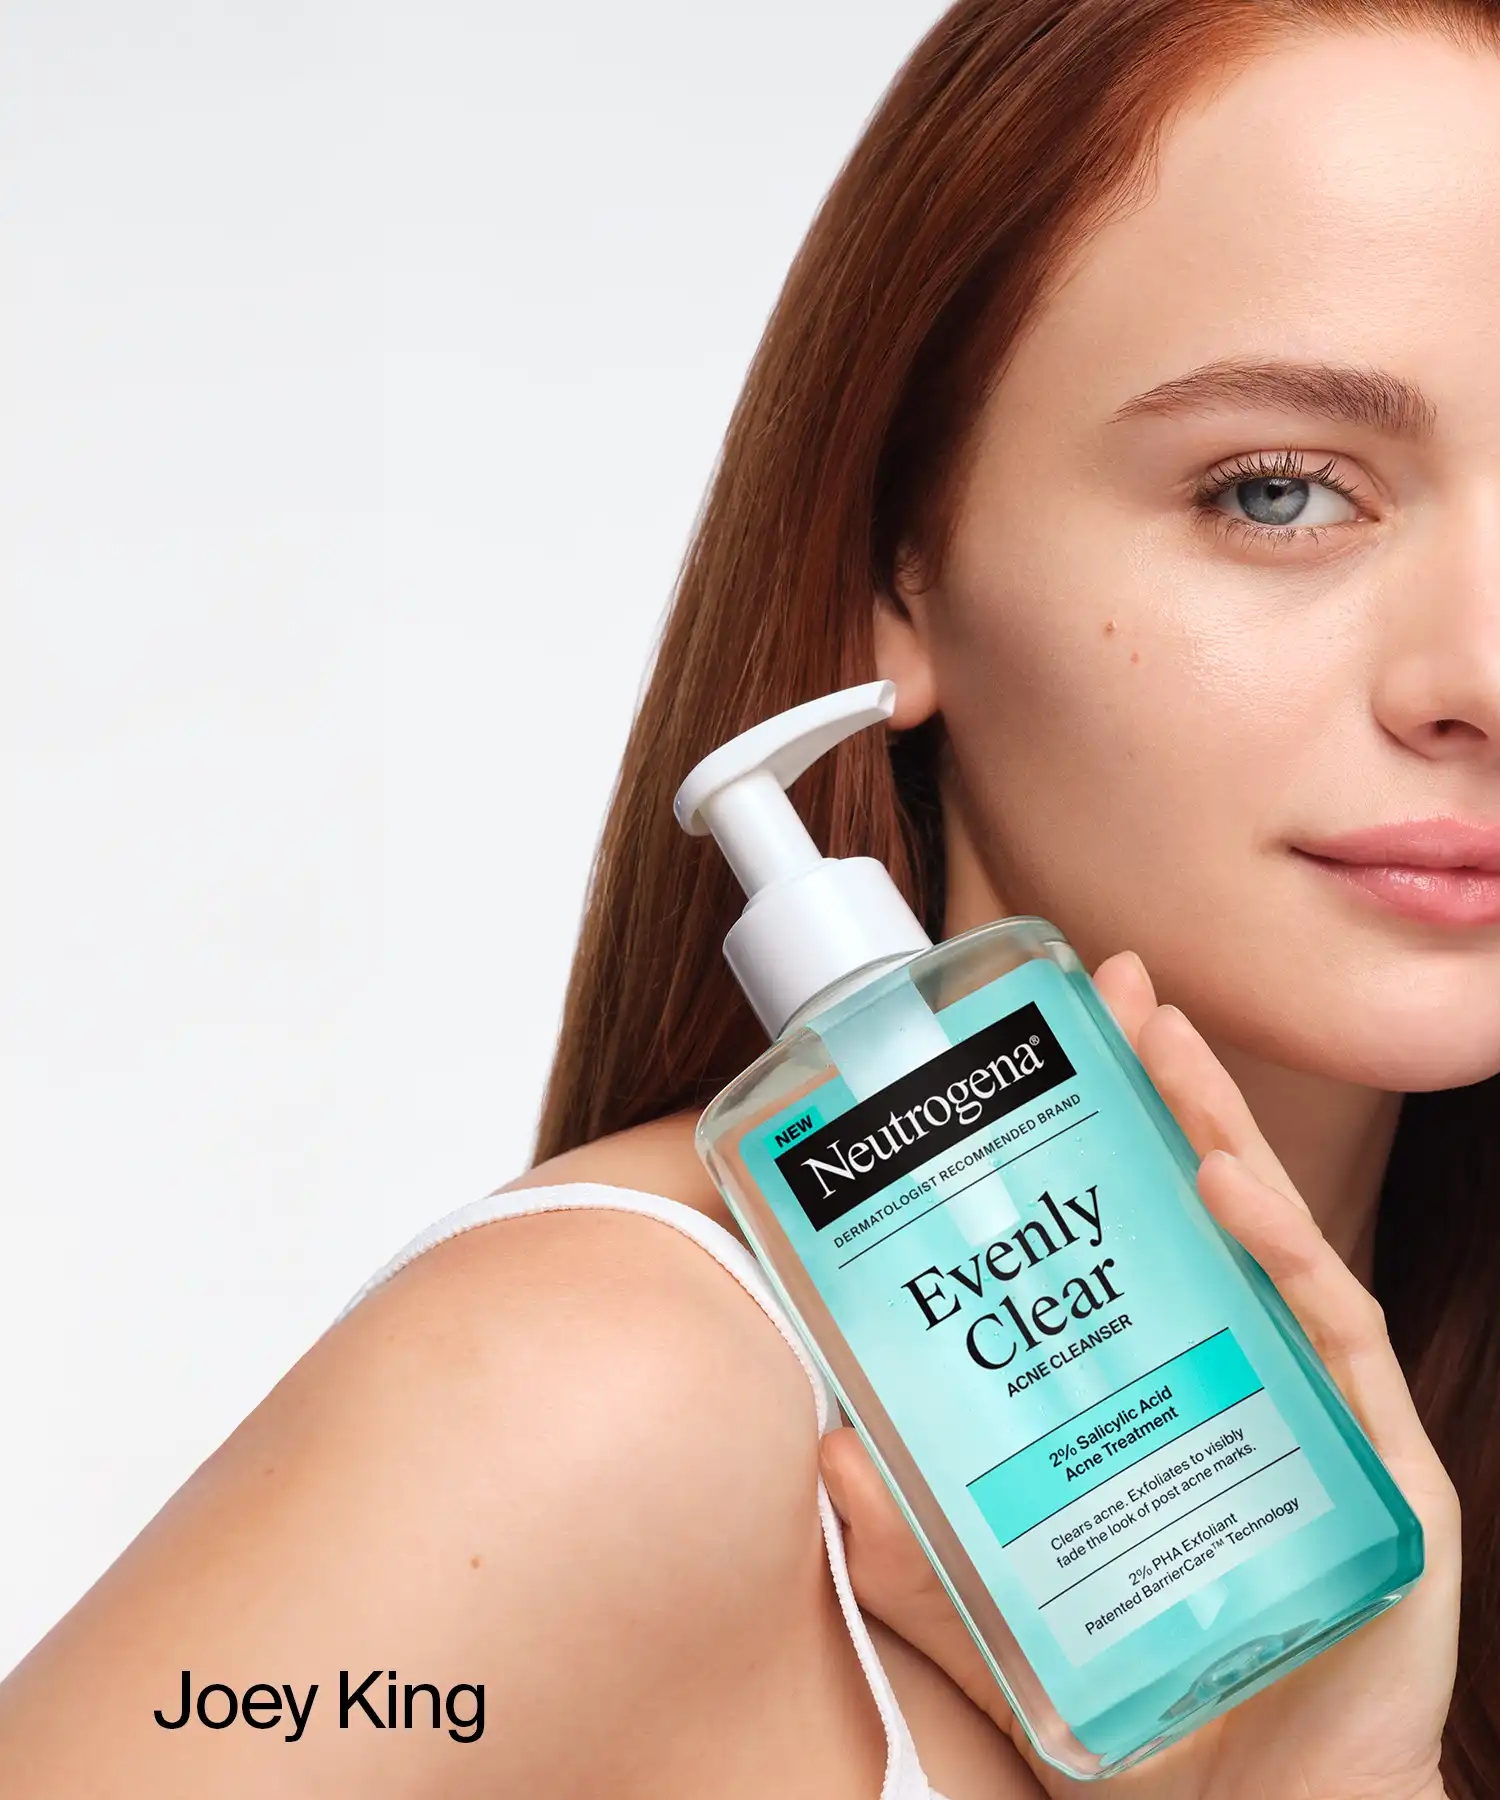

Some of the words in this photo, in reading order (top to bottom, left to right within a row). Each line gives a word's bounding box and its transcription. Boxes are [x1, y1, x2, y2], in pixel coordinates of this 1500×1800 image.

[774, 1114, 813, 1148] NEW
[833, 1176, 937, 1249] DERMATOLOGIST
[938, 1119, 1036, 1182] RECOMMENDED
[1036, 1093, 1081, 1125] BRAND
[900, 1184, 1103, 1331] Evenly
[966, 1237, 1125, 1370] Clear
[1007, 1361, 1051, 1398] ACNE
[1049, 1314, 1133, 1369] CLEANSER
[1048, 1443, 1078, 1468] 2%
[1076, 1408, 1139, 1450] Salicylic
[1139, 1384, 1173, 1414] Acid
[1065, 1453, 1104, 1483] Acne
[1100, 1405, 1180, 1457] Treatment
[1050, 1520, 1093, 1551] Clears
[1093, 1500, 1129, 1525] acne.
[1127, 1460, 1191, 1503] Exfoliates
[1189, 1452, 1205, 1465] to
[1204, 1427, 1244, 1456] visibly
[1056, 1545, 1087, 1569] fade
[1085, 1531, 1109, 1550] the
[1107, 1513, 1138, 1536] look
[1137, 1501, 1151, 1518] of
[1151, 1485, 1181, 1512] post
[1180, 1467, 1213, 1492] acne
[1212, 1444, 1257, 1473] marks.
[1128, 1565, 1153, 1587] 2%
[1151, 1546, 1184, 1571] PHA
[1181, 1512, 1238, 1553] Exfoliant
[1084, 1591, 1143, 1636] Patented
[1225, 1497, 1299, 1545] Technology
